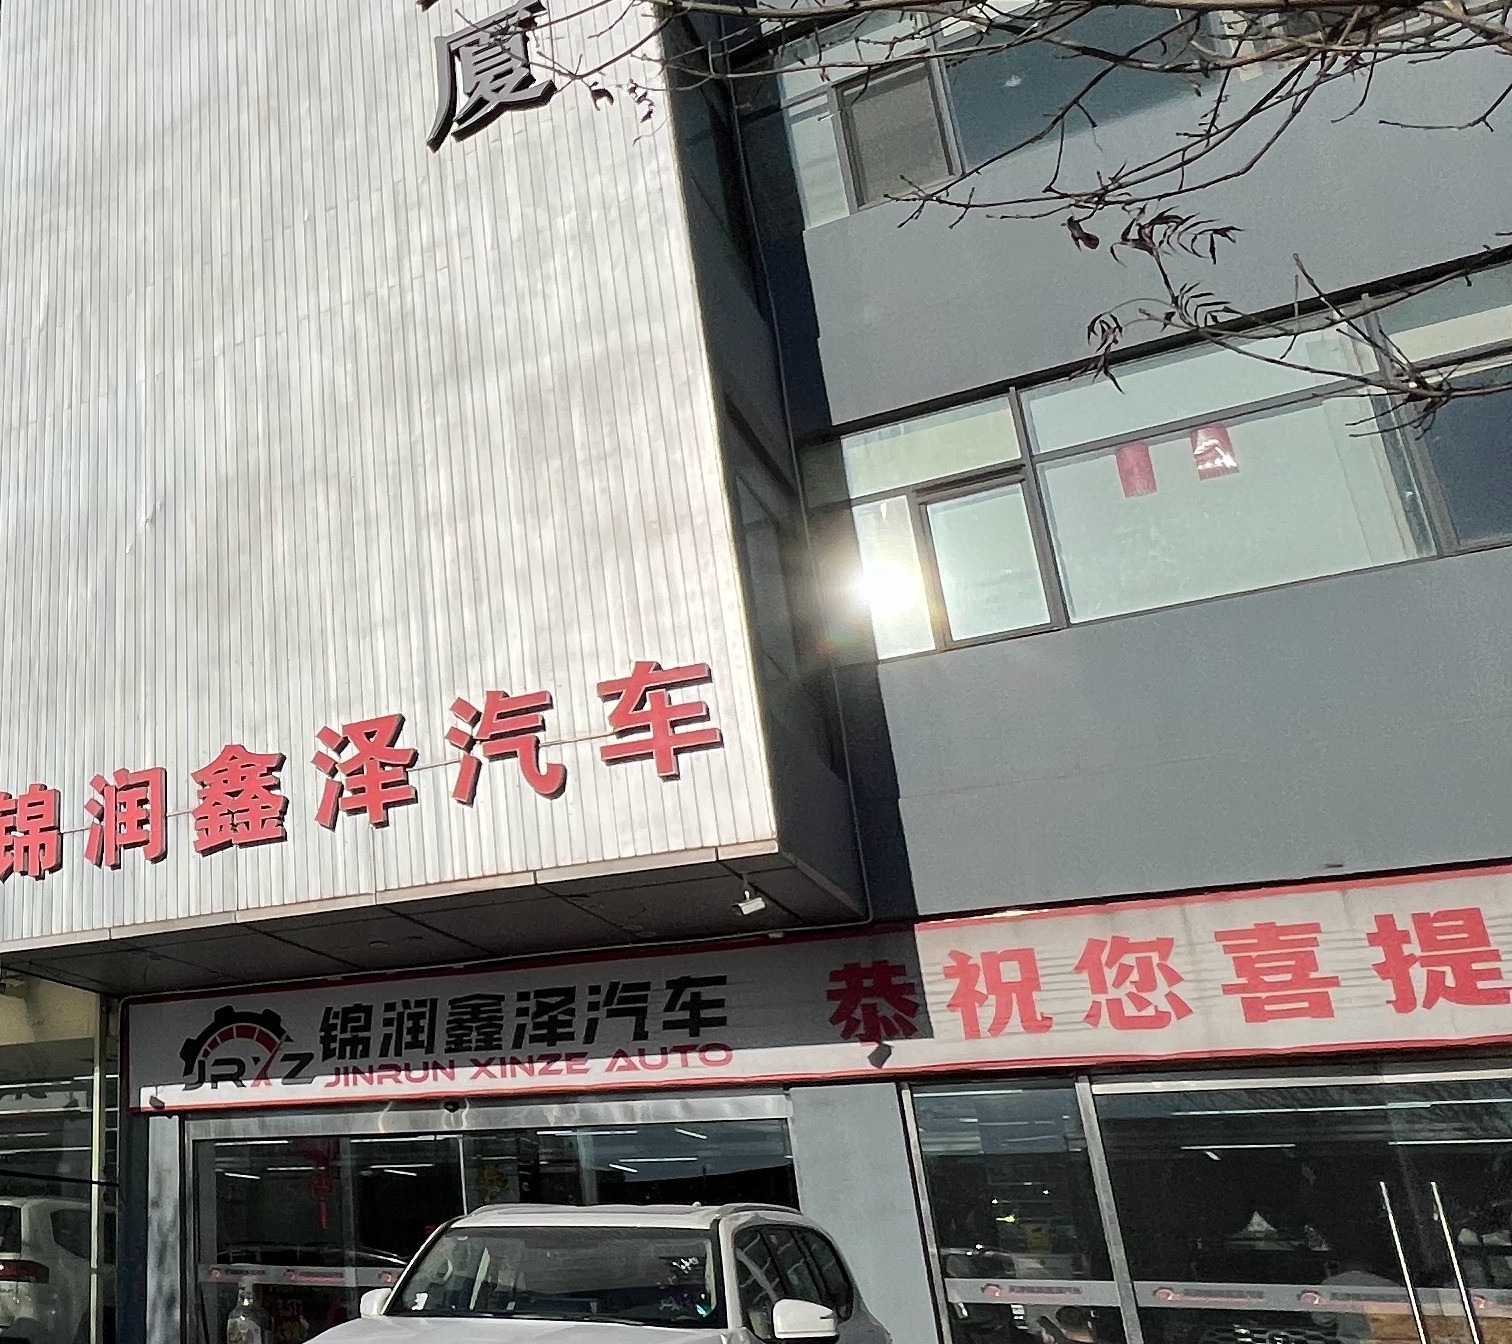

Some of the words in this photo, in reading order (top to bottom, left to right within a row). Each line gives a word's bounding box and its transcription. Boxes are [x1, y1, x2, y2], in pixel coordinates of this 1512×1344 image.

[318, 974, 728, 1062] 锦润鑫泽汽车
[826, 907, 1510, 1046] 恭祝您喜提
[325, 1061, 456, 1088] JINRUN
[470, 1051, 589, 1081] XINZE
[604, 1043, 734, 1073] AUTO
